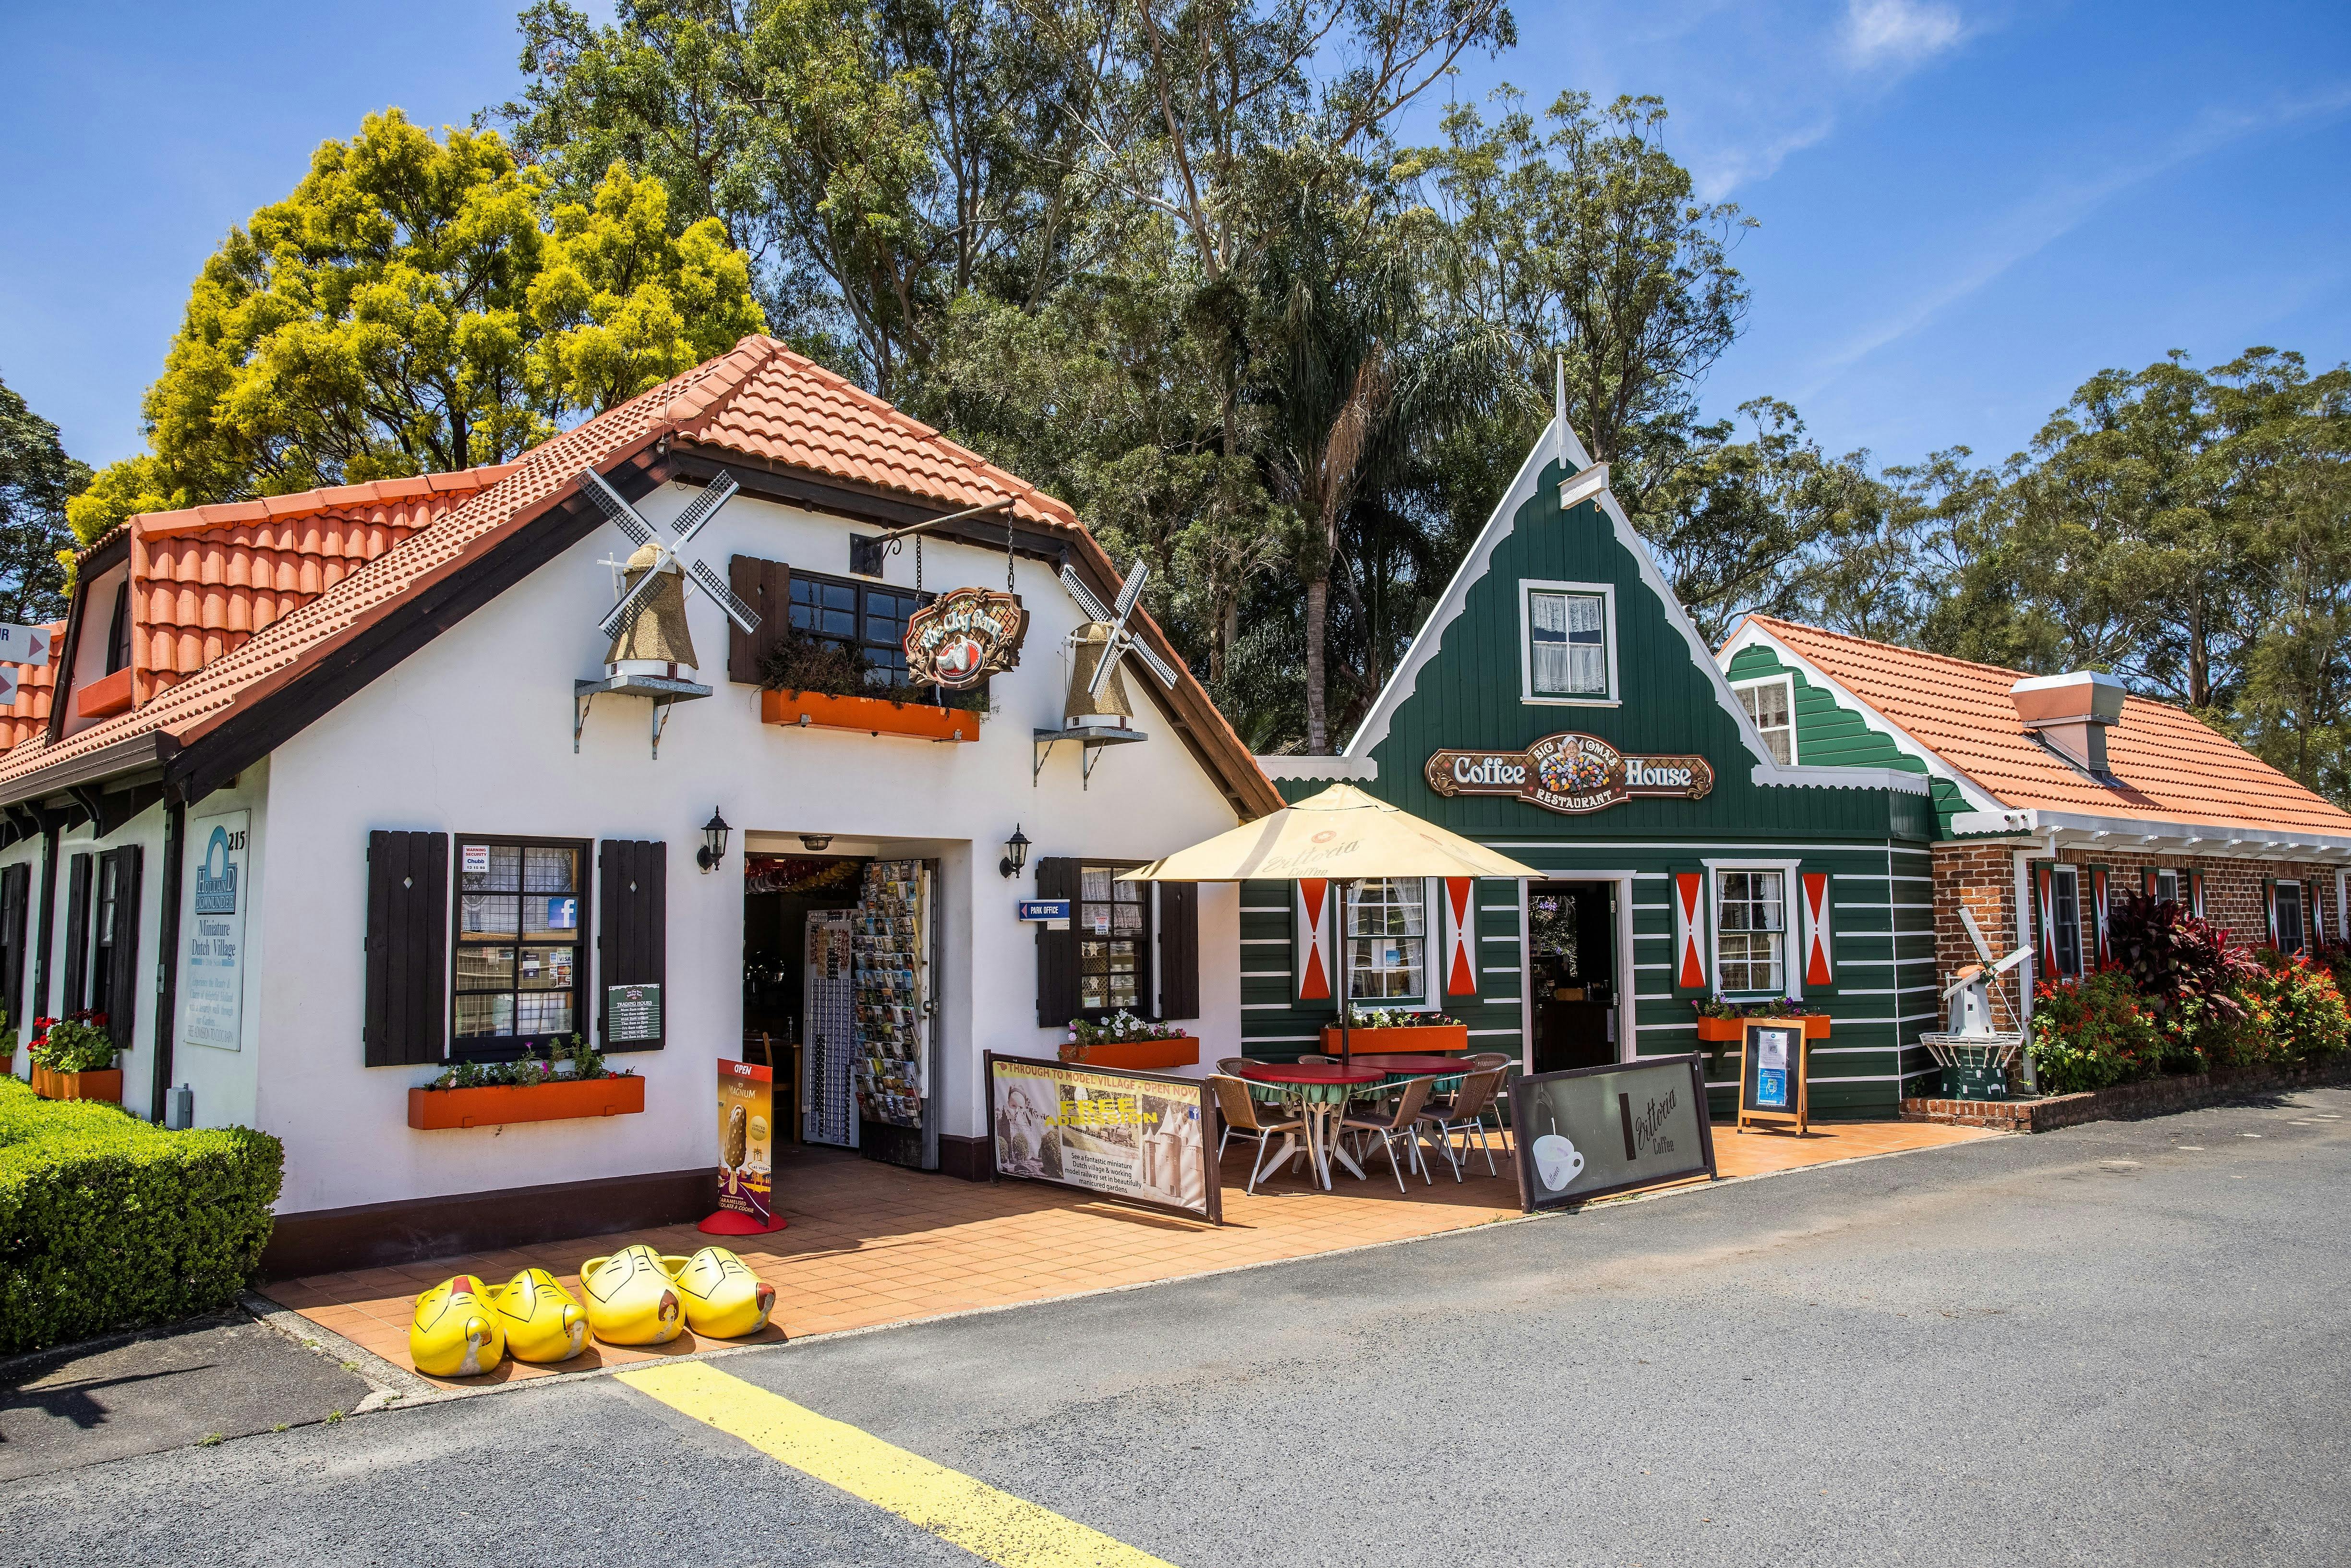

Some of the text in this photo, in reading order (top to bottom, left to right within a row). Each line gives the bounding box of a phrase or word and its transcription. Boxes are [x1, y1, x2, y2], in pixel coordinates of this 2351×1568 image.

[920, 609, 1002, 651] The Clog Barn
[1533, 740, 1618, 767] BIG OMA'S
[1454, 757, 1692, 786] Coffee House
[1536, 788, 1612, 808] RESTAURANT
[228, 831, 245, 851] 215
[1262, 840, 1360, 873] Vittoria
[197, 868, 235, 893] HOLLAND
[1288, 867, 1328, 877] Coffee
[196, 896, 234, 909] DOWNUNDER
[198, 919, 230, 936] Miniature
[192, 939, 236, 960] Dutch Village
[735, 1064, 752, 1075] OPEN
[1008, 1063, 1049, 1078] THROUGH
[1051, 1070, 1063, 1080] TO
[1066, 1072, 1096, 1085] MODEL
[1097, 1075, 1135, 1090] VILLAGE
[1144, 1082, 1170, 1095] OPEN
[1173, 1086, 1199, 1098] NOW
[728, 1085, 757, 1099] MAGNUM
[1060, 1098, 1137, 1115] FREE
[1045, 1112, 1158, 1128] ADMISSION
[1636, 1088, 1676, 1150] Vittoria
[1653, 1136, 1674, 1155] Coffee
[1073, 1160, 1087, 1169] Dutch
[1088, 1164, 1104, 1173] village
[1110, 1170, 1132, 1179] working
[1085, 1155, 1106, 1165] fantastic
[1107, 1160, 1132, 1170] miniature
[1079, 1179, 1127, 1193] manicured gardens
[1081, 1171, 1098, 1181] railway
[1114, 1177, 1142, 1189] beautifully
[719, 1197, 747, 1206] CARAMELISED
